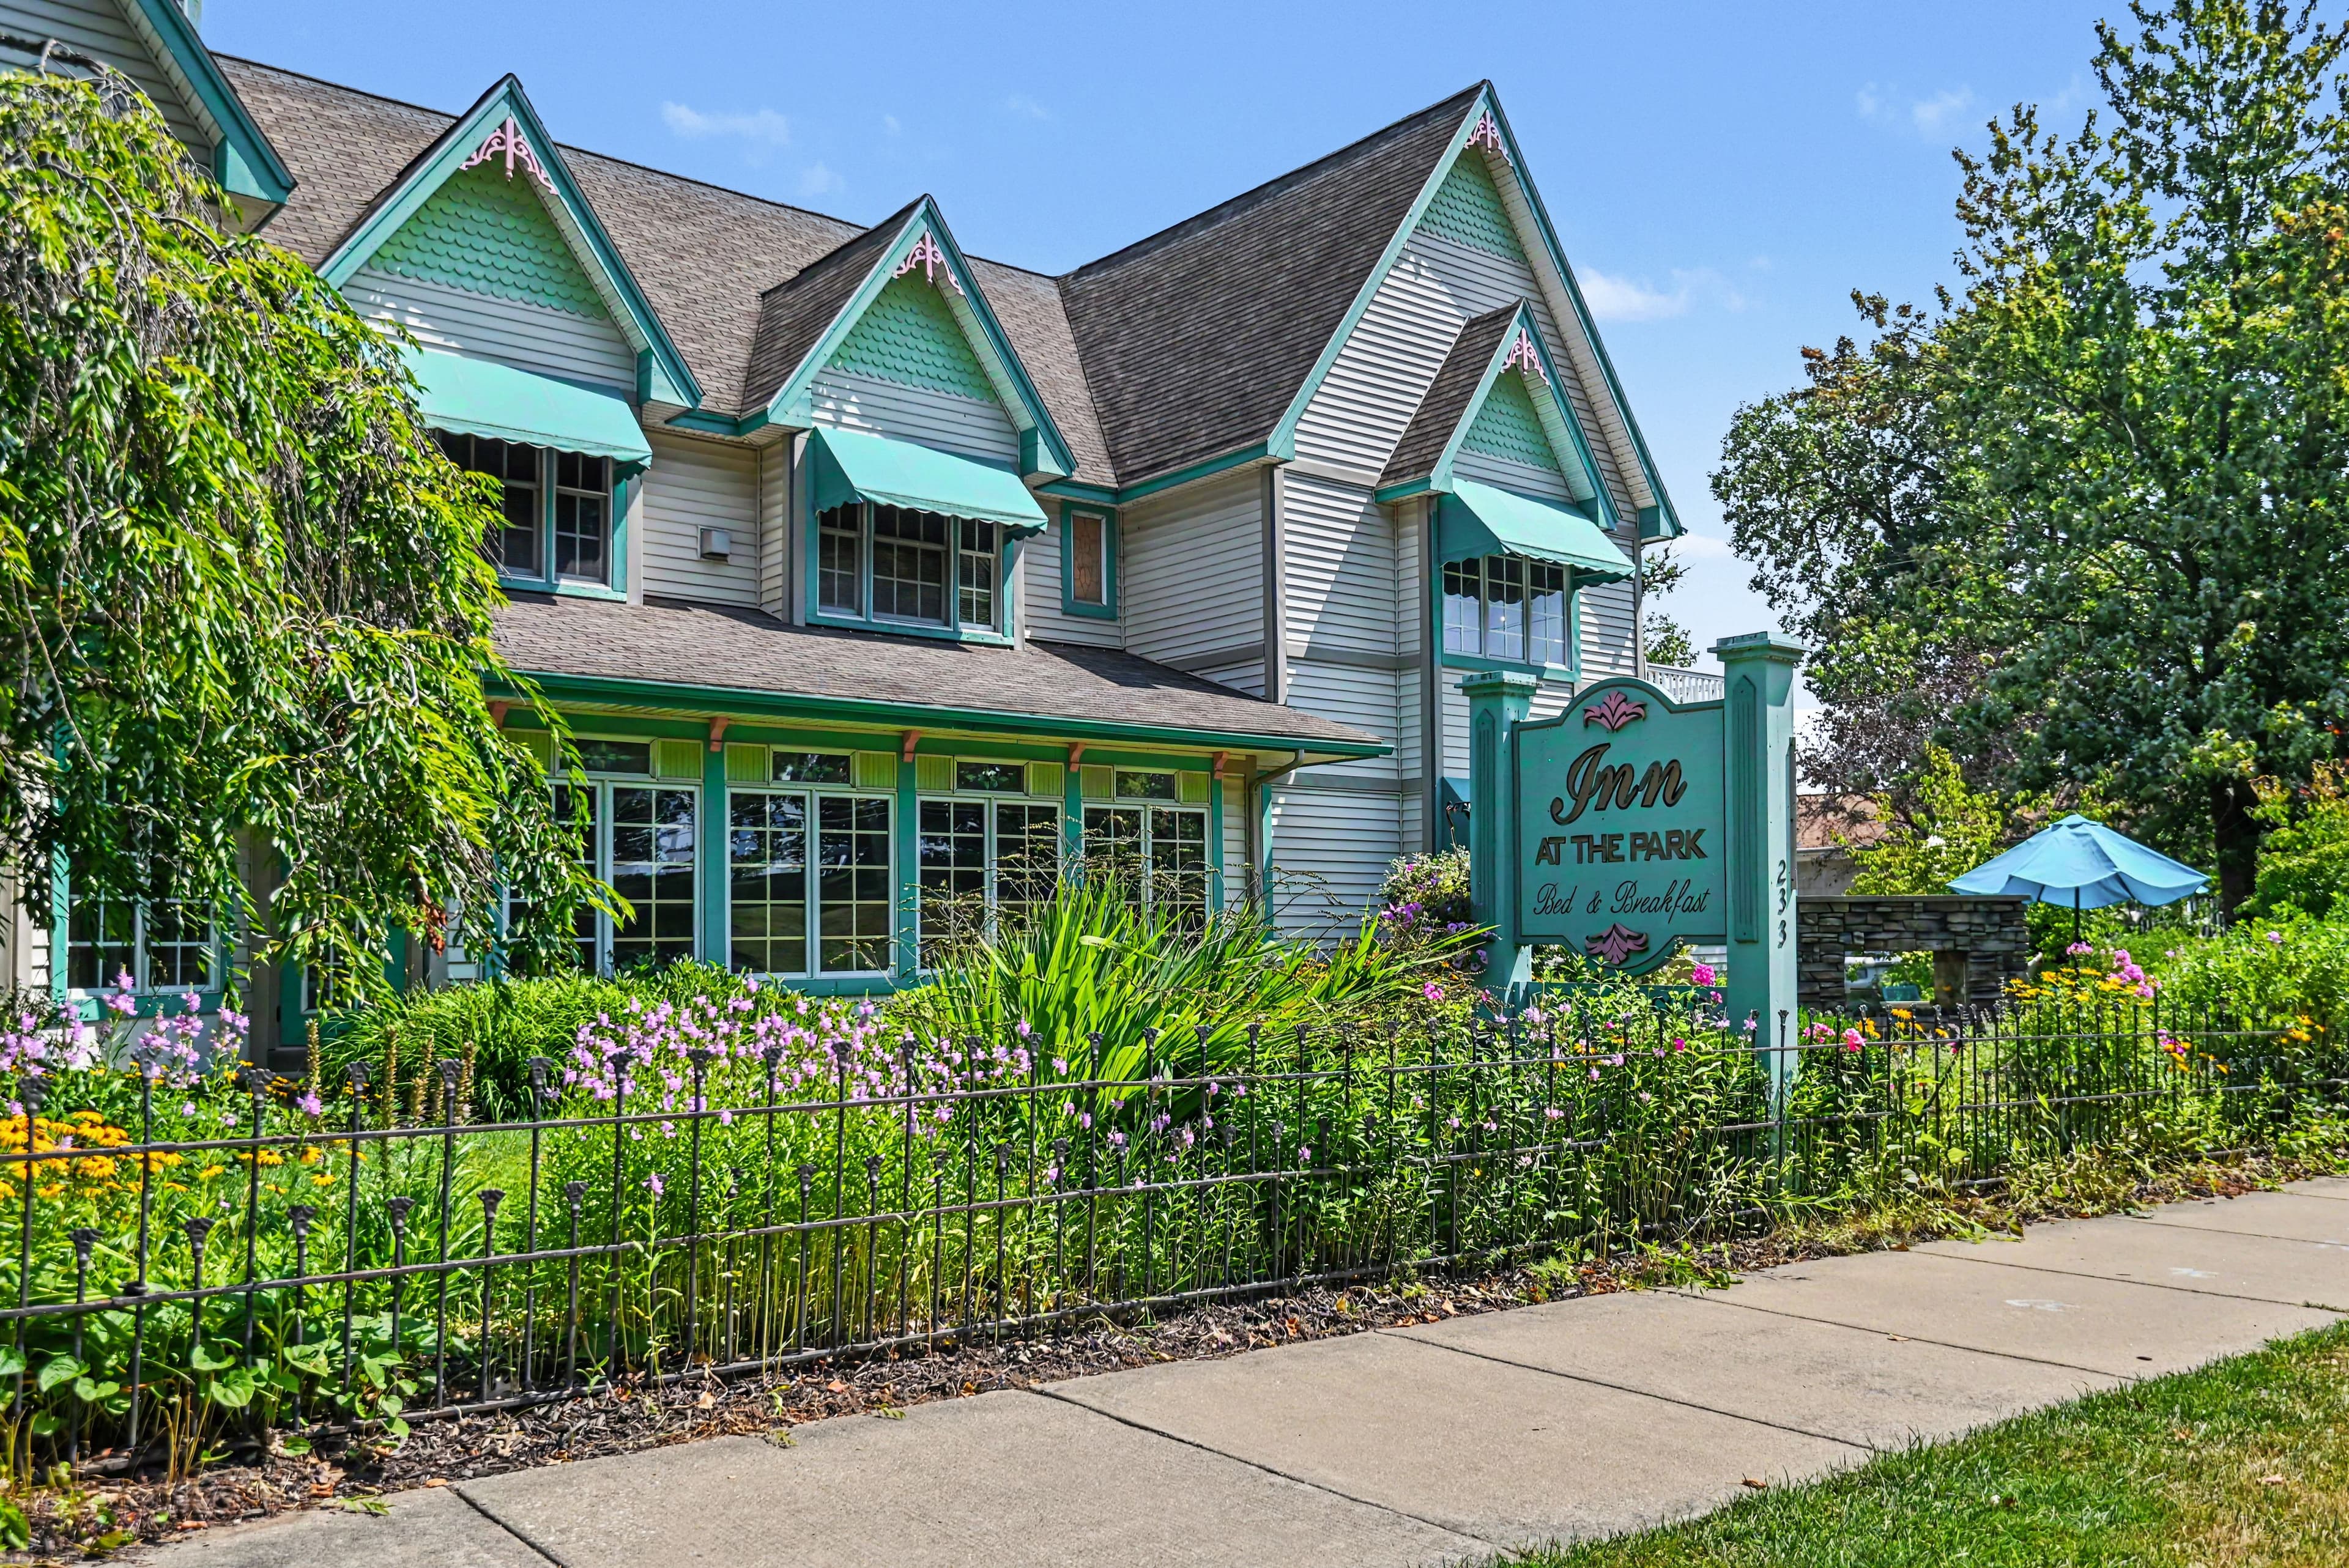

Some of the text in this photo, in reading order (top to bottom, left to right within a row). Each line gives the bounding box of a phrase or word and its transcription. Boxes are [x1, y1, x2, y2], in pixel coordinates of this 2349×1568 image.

[1550, 742, 1688, 826] Inn
[1535, 829, 1708, 865] AT THE PARK
[1534, 879, 1711, 924] Bed & Breakfast
[1776, 859, 1787, 949] 233
